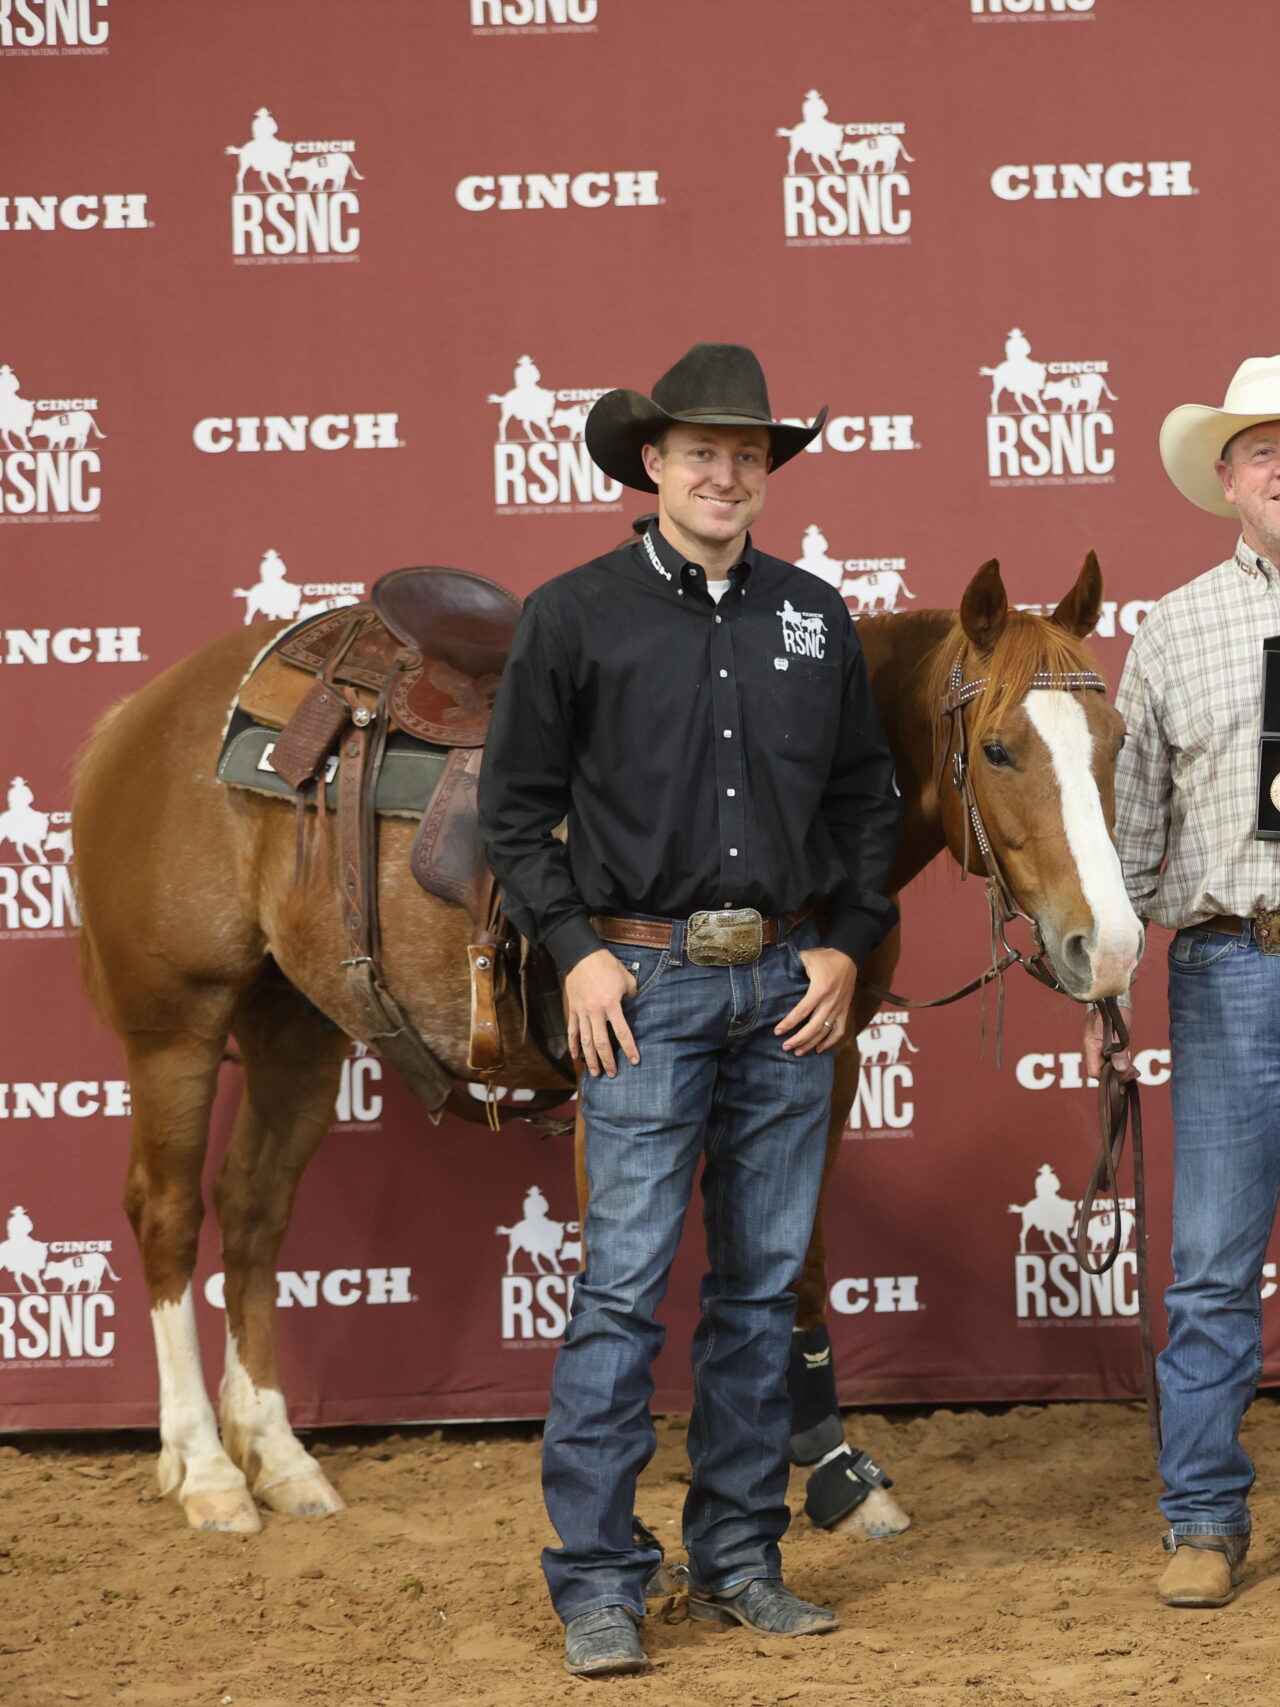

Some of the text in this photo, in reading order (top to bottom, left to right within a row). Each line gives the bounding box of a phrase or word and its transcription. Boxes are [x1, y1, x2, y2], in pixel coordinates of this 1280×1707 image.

[294, 140, 356, 154] CINCH
[843, 122, 906, 136] CINCH
[455, 172, 658, 212] CINCH
[990, 160, 1199, 201] CINCH
[232, 192, 361, 255] RSNC
[783, 174, 912, 237] RSNC
[1047, 360, 1109, 374] CINCH
[36, 398, 98, 411] CINCH
[556, 388, 617, 402] CINC
[192, 412, 398, 454] CINCH
[772, 414, 914, 453] NCH
[987, 412, 1115, 477] RSNC
[0, 451, 102, 514] SNC
[643, 531, 672, 581] CINCH
[843, 557, 905, 572] CINCH
[303, 582, 366, 596] CINCH
[0, 627, 142, 665] NCH
[782, 629, 826, 660] RSNC
[0, 864, 82, 930] RSN
[869, 1011, 910, 1025] NCH
[1015, 1048, 1172, 1091] CIC
[847, 1064, 914, 1130] NC
[49, 1240, 113, 1254] CINCH
[204, 1267, 411, 1310] CNCH
[1016, 1253, 1141, 1318] RSNC
[502, 1275, 578, 1339] RS
